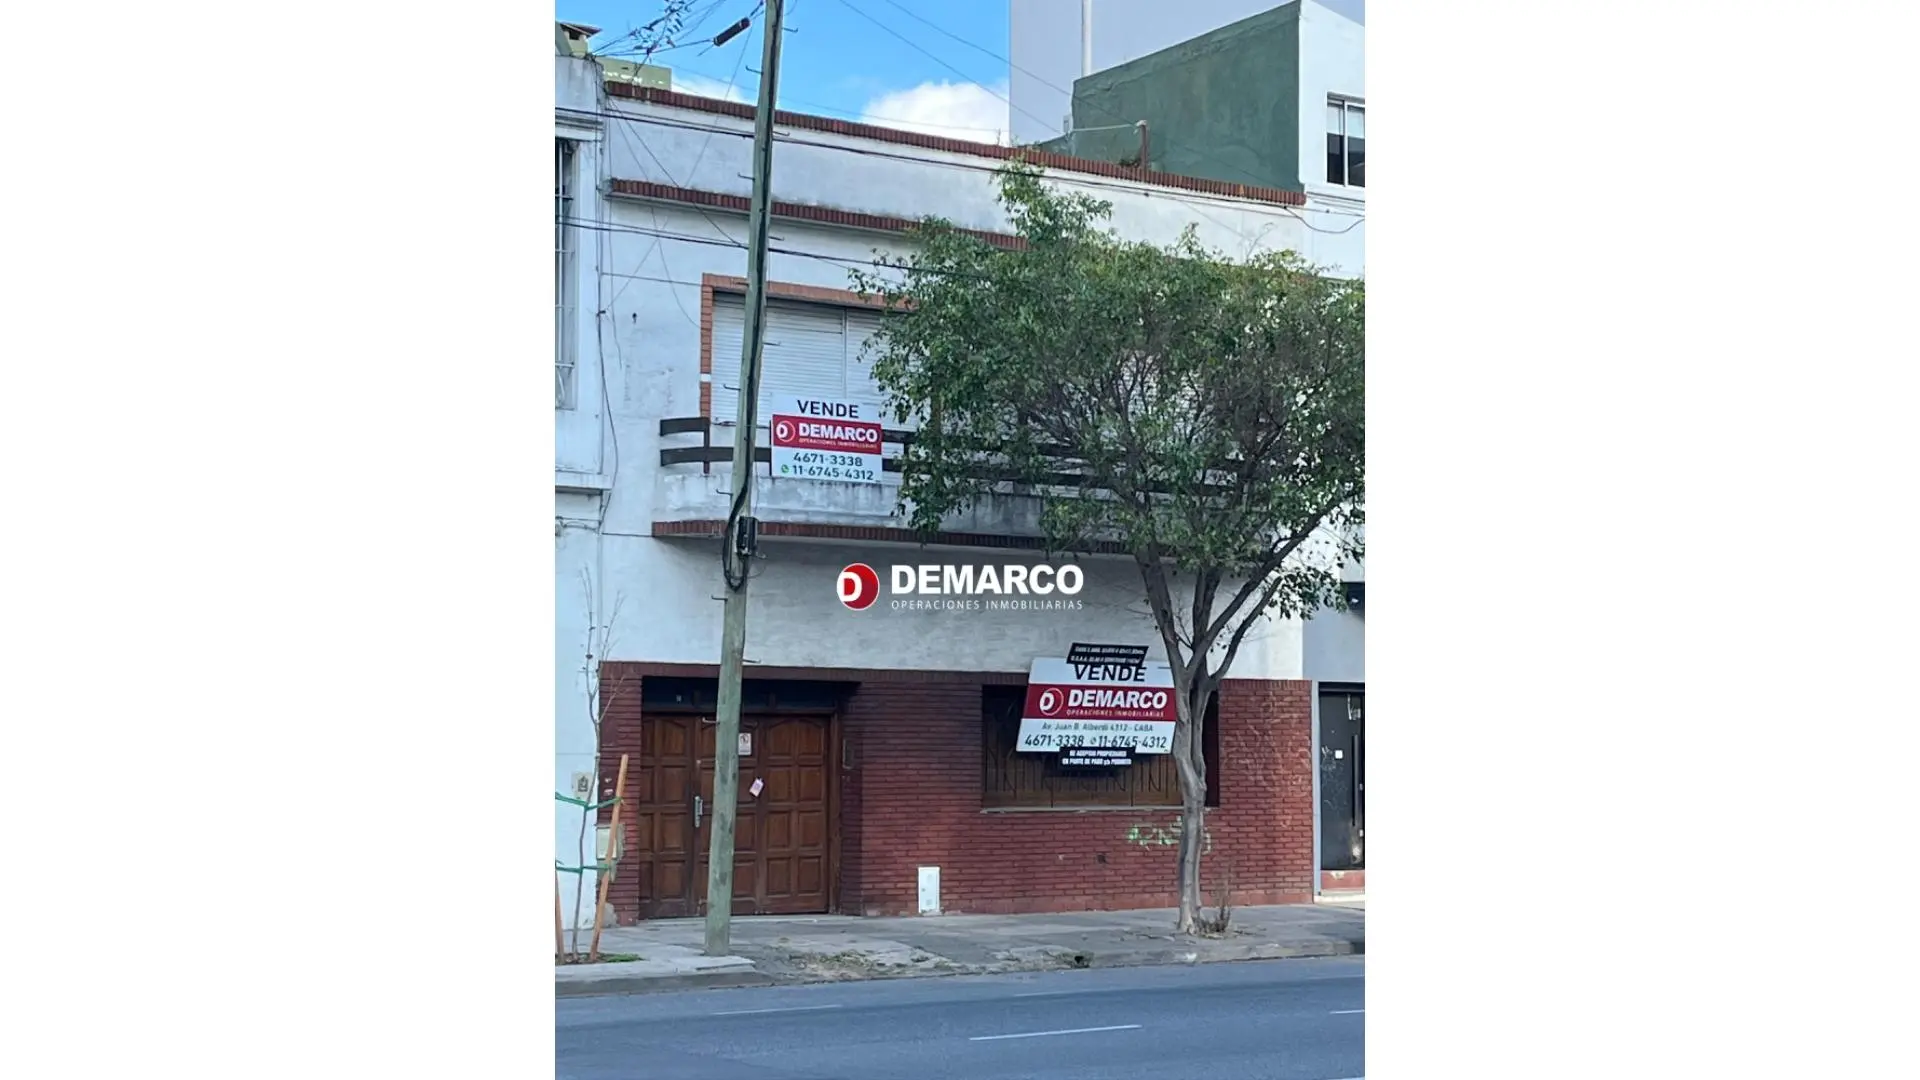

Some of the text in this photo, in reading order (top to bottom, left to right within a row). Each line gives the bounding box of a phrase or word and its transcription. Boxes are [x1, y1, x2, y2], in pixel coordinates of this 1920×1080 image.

[797, 399, 859, 418] VENDE
[799, 422, 878, 443] DEMARCO
[793, 452, 863, 467] 4671-3338
[792, 464, 874, 480] 11-6745-4312
[1074, 663, 1147, 682] VENDE
[1067, 689, 1167, 709] DEMARCO
[1066, 708, 1164, 718] OPERACIONES INMOBILIARIAS
[1055, 722, 1072, 731] Juan
[1025, 734, 1167, 749] 4671-3338 11-6745-4312
